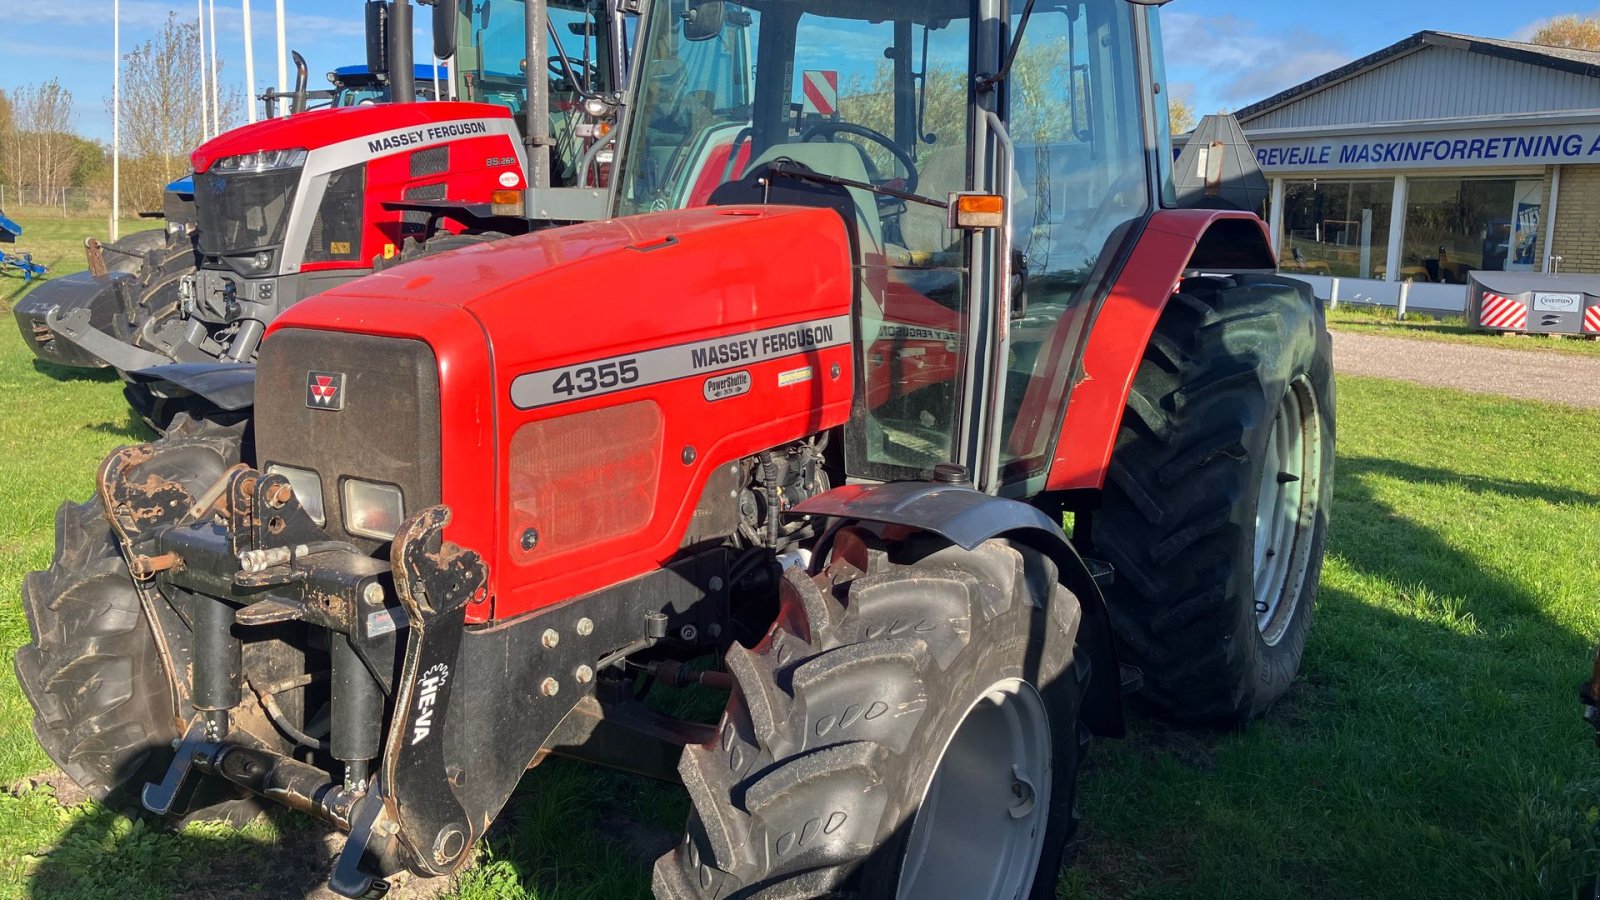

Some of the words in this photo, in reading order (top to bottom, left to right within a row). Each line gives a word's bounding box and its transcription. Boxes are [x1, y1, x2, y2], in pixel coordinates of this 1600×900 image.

[368, 130, 424, 153] MASSEY
[429, 122, 487, 141] FERGUSON
[1339, 134, 1583, 164] MASKINFORRETNING
[691, 338, 758, 369] MASSEY
[762, 324, 833, 355] FERGUSON
[552, 358, 639, 396] 4355
[708, 374, 747, 392] PowerShuttle
[411, 676, 440, 745] HE-VA
